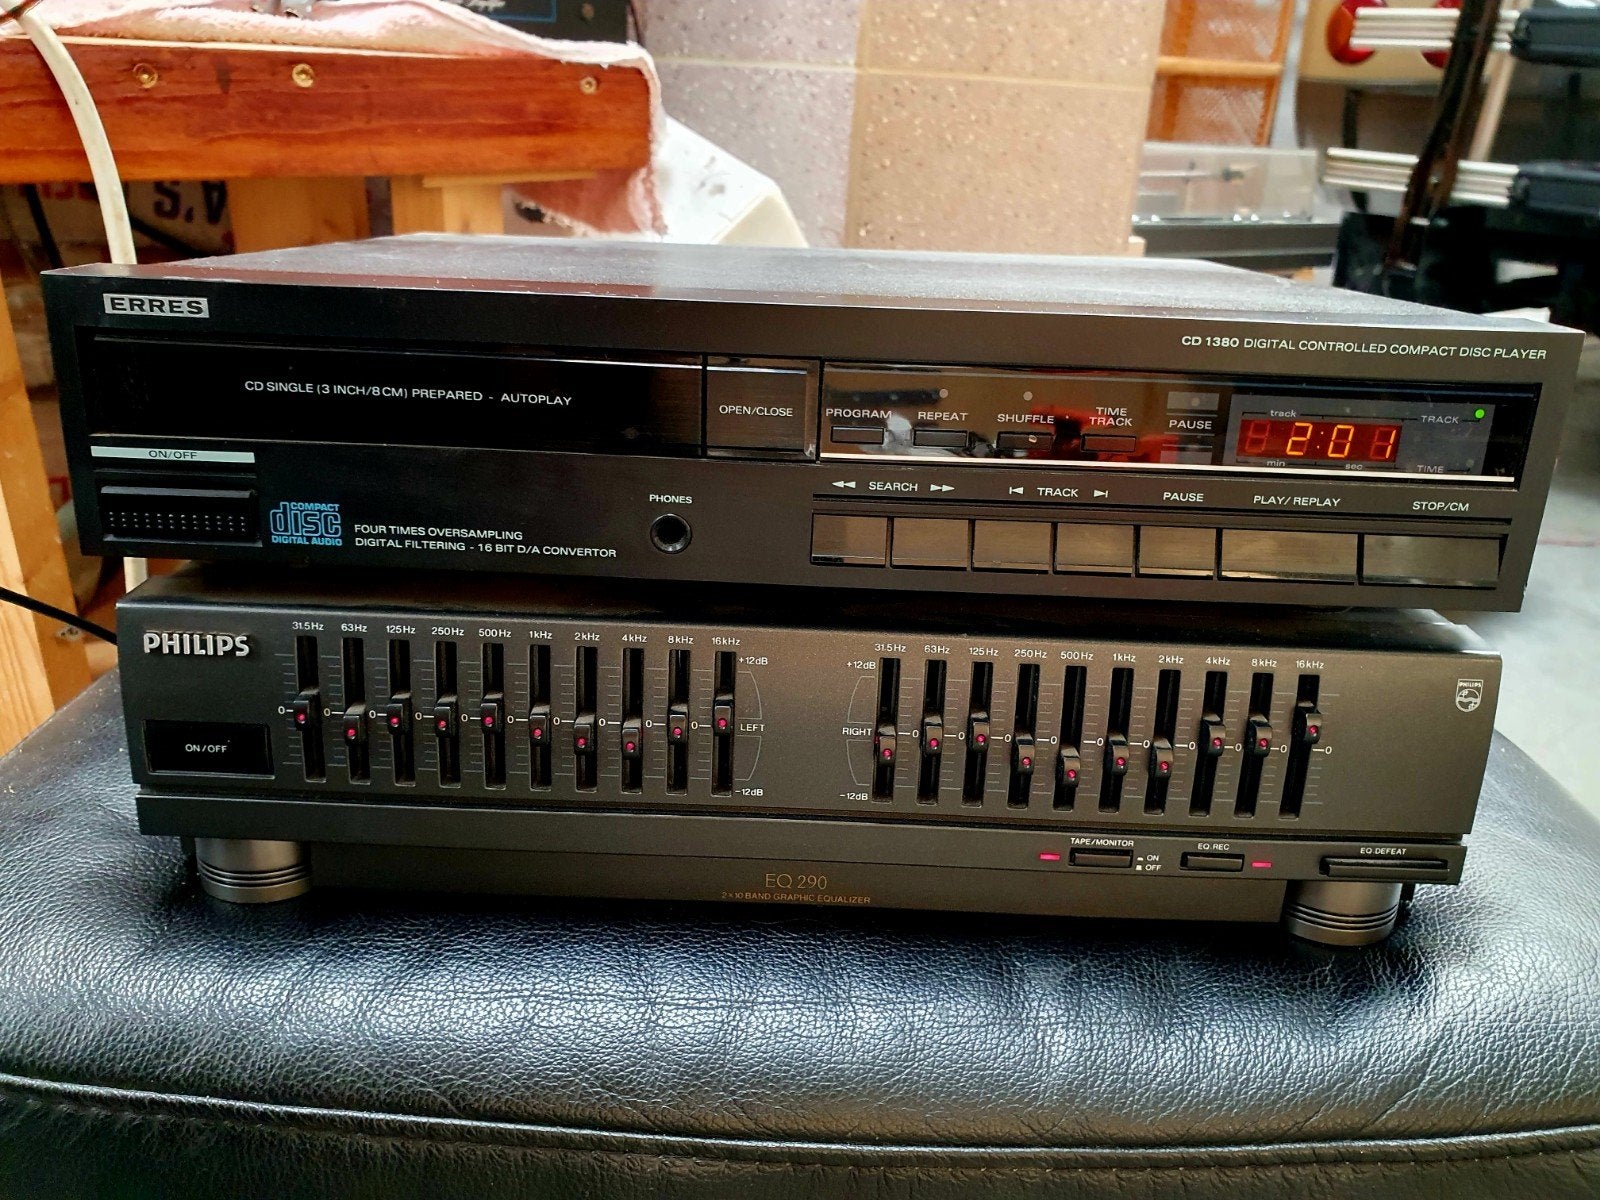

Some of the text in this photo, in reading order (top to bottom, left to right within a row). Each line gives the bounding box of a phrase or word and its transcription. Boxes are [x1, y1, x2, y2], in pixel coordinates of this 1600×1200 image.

[110, 297, 204, 315] ERRES
[1181, 336, 1547, 359] CD 1380 DIGITAL CONTROLLED COMPACT DISC PLAYER
[245, 381, 264, 391] CD
[266, 382, 313, 393] SINGLE
[317, 384, 330, 394] (3
[412, 388, 483, 401] PREPARED
[501, 393, 572, 406] AUTOPLAY
[719, 405, 793, 417] OPEN/CLOSE
[826, 408, 892, 419] PROGRAM
[1096, 407, 1127, 416] TIME
[1270, 409, 1297, 418] track
[918, 411, 968, 421] REPEAT
[997, 414, 1054, 424] SHUFFLE
[1421, 415, 1459, 424] TRACK
[1089, 417, 1132, 427] TRACK
[1169, 420, 1212, 430] PAUSE
[148, 450, 197, 459] ON/OFF
[1417, 465, 1444, 473] TIME
[869, 482, 918, 491] SEARCH
[1037, 487, 1079, 498] TRACK
[1163, 492, 1204, 502] PAUSE
[649, 495, 692, 503] PHONES
[290, 502, 340, 511] COMPACT
[1412, 501, 1469, 512] STOP/CM
[355, 525, 523, 540] FOUR TIMES OVERSAMPLING
[272, 535, 342, 546] DIGITAL AUDIO
[355, 538, 402, 548] DIGITAL
[405, 540, 466, 551] FILTERING
[496, 544, 514, 552] BIT
[518, 545, 540, 554] D/A
[543, 546, 617, 557] CONVERTOR
[292, 622, 324, 631] 31.5Hz
[341, 623, 367, 632] 63Hz
[386, 626, 416, 635] 125Hz
[432, 627, 464, 637] 250Hz
[479, 629, 511, 638] 500Hz
[529, 631, 552, 640] 1kHz
[574, 632, 600, 641] 2kHz
[622, 634, 647, 643] 4kHz
[668, 636, 694, 645] 8kHz
[711, 637, 740, 646] 16kHz
[143, 633, 249, 657] PHILIPS
[874, 644, 906, 653] 31.5Hz
[924, 645, 950, 654] 63Hz
[969, 647, 999, 657] 125Hz
[1014, 649, 1047, 659] 250Hz
[1060, 651, 1094, 660] 500Hz
[739, 657, 768, 666] +12dB
[1113, 653, 1136, 662] 1kHz
[1158, 655, 1183, 664] 2kHz
[1205, 657, 1230, 666] 4kHz
[847, 660, 876, 670] +12dB
[1251, 658, 1277, 667] 8kHz
[1296, 660, 1324, 669] 16kHz
[278, 706, 285, 715] 0
[324, 708, 331, 717] 0
[369, 710, 376, 719] 0
[415, 712, 422, 720] 0
[461, 714, 468, 722] 0
[507, 716, 514, 724] 0
[553, 717, 560, 725] 0
[599, 718, 606, 727] 0
[646, 720, 652, 728] 0
[691, 721, 698, 730] 0
[740, 724, 765, 732] LEFT
[842, 727, 872, 736] RIGHT
[912, 729, 919, 738] 0
[958, 732, 965, 740] 0
[1004, 734, 1011, 742] 0
[1050, 736, 1057, 744] 0
[1096, 738, 1103, 746] 0
[1143, 740, 1150, 748] 0
[1188, 742, 1195, 750] 0
[1235, 743, 1242, 751] 0
[1280, 745, 1287, 753] 0
[1325, 746, 1332, 754] 0
[735, 788, 763, 796] -12dB
[839, 792, 868, 801] -12dB
[1071, 837, 1134, 847] TAPE/MONITOR
[765, 874, 827, 890] EQ 290
[745, 892, 770, 900] BAND
[773, 893, 815, 902] GRAPHIC
[818, 895, 870, 904] EQUALIZER
